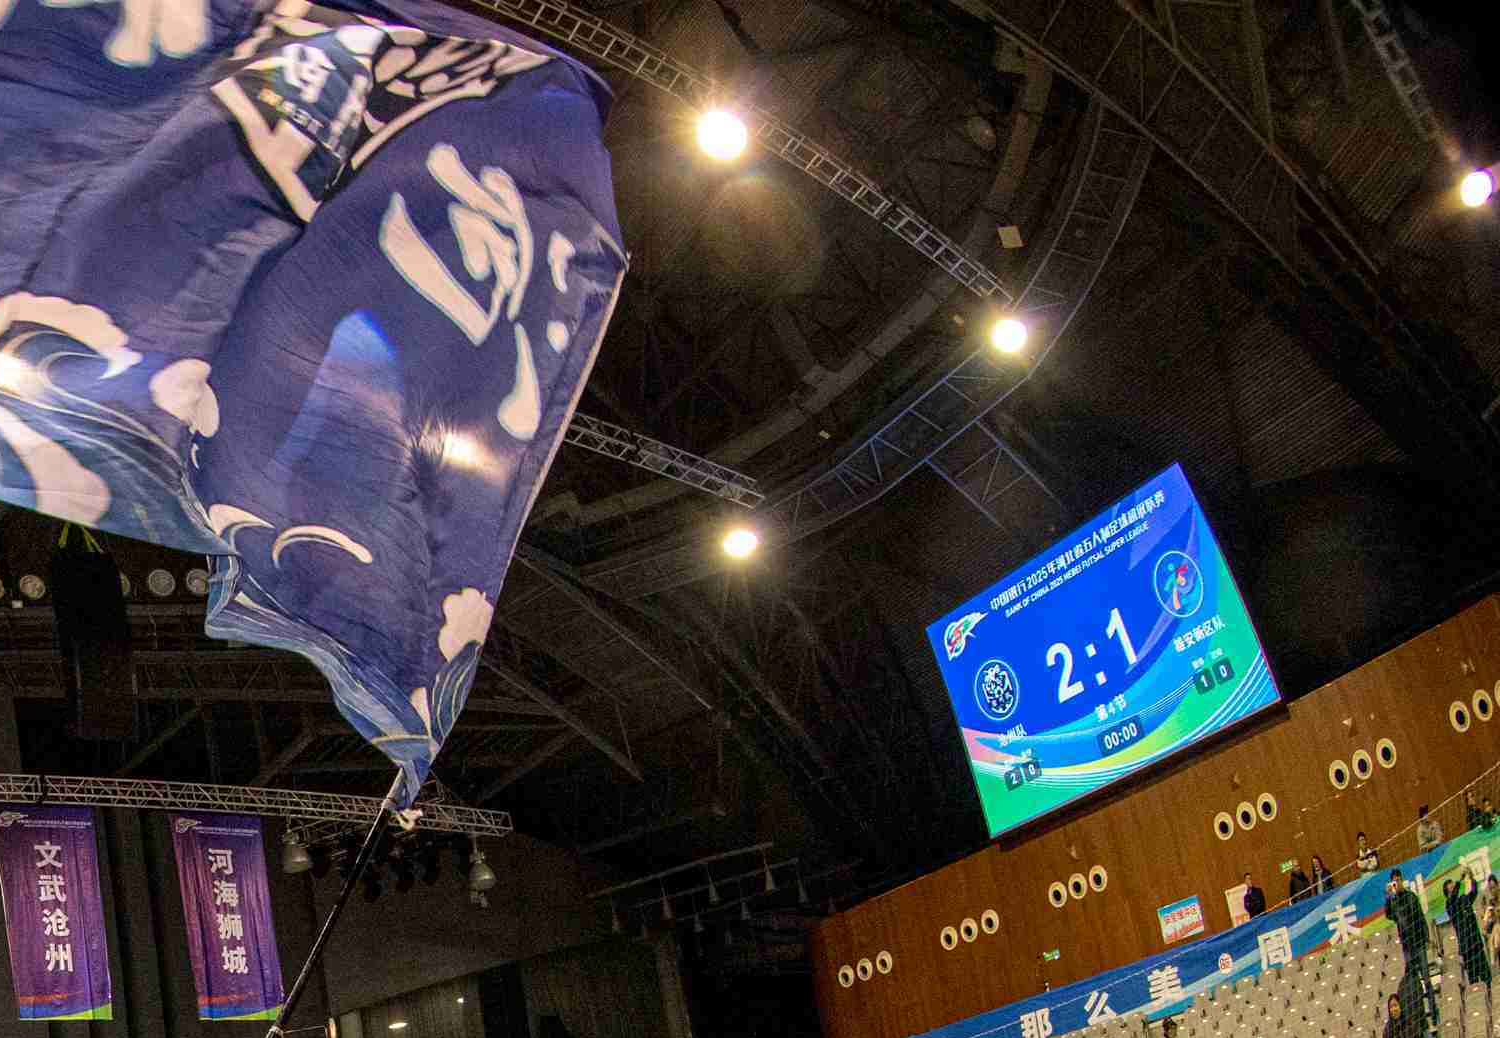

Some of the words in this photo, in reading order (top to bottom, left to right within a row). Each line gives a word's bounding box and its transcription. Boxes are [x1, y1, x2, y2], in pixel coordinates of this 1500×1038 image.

[1104, 724, 1138, 750] 00:00
[33, 841, 74, 973] 文武沧州
[207, 847, 250, 975] 河海狮城
